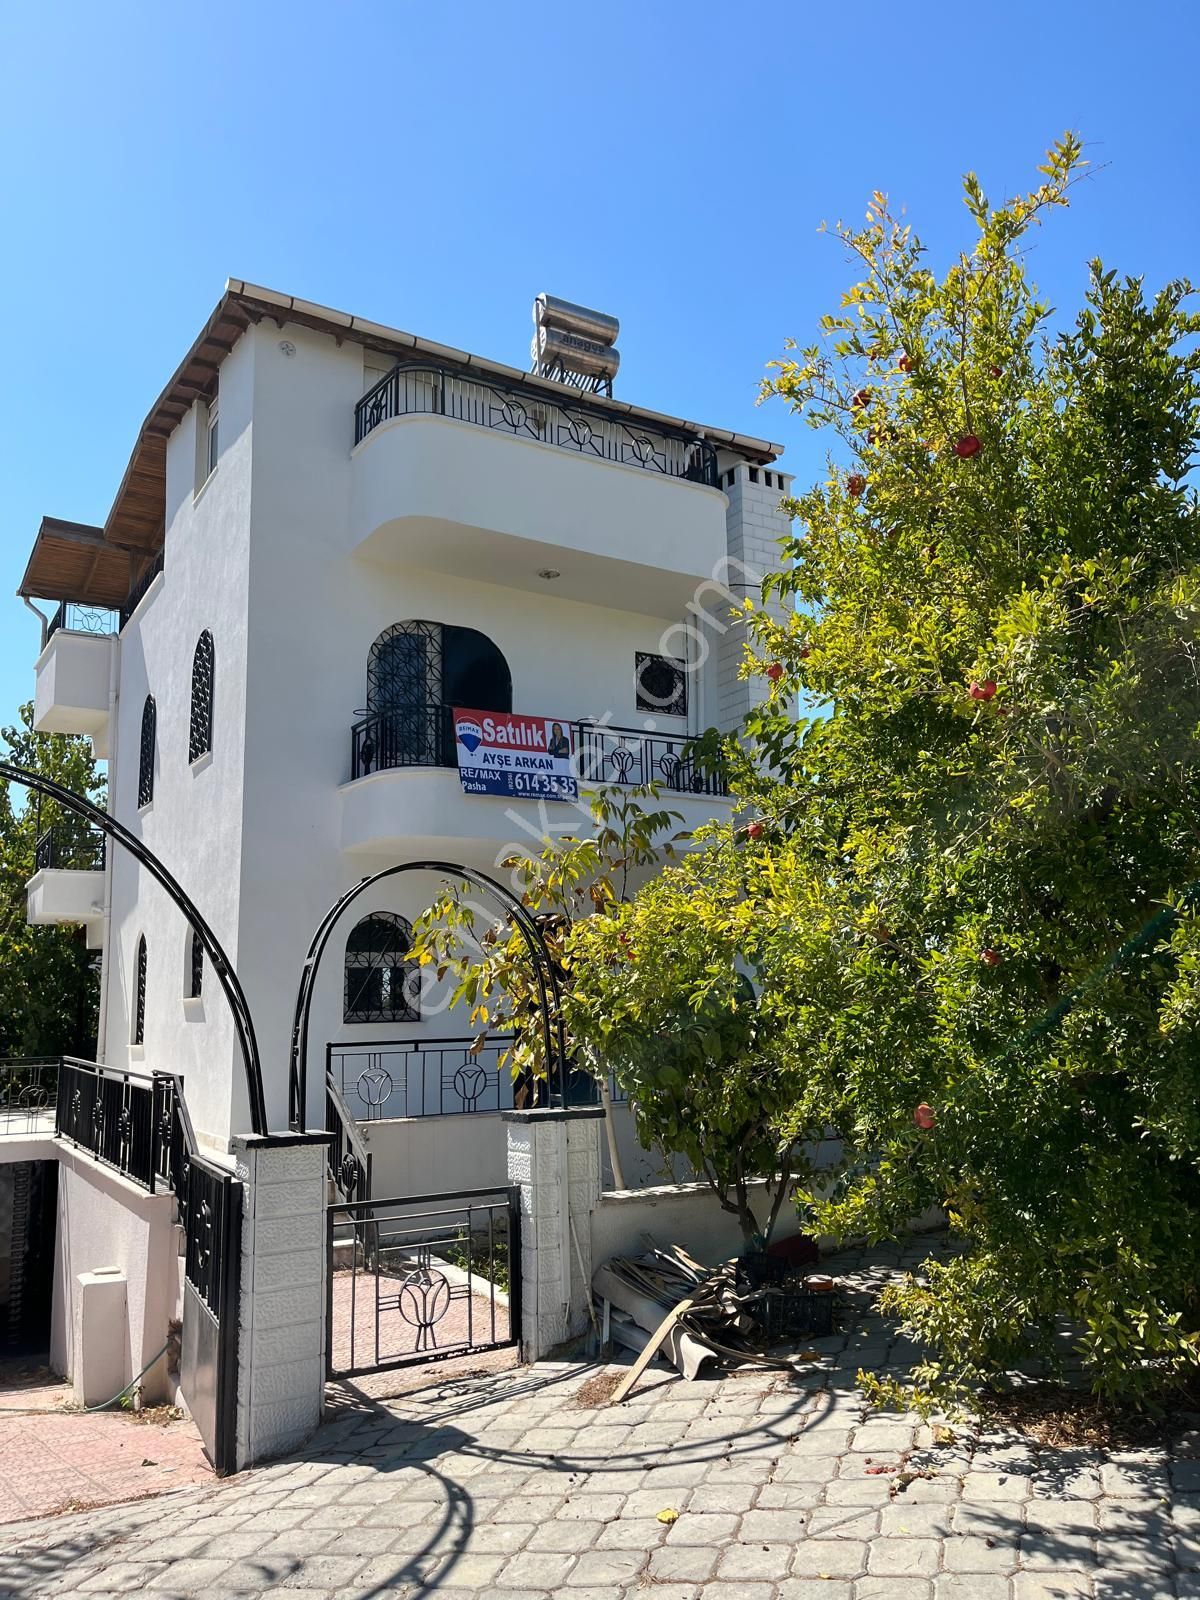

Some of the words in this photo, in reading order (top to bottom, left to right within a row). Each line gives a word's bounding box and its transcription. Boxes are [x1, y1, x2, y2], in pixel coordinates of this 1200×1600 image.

[482, 718, 545, 748] Satılık
[482, 753, 512, 769] AYŞE
[515, 756, 554, 770] ARKAN
[460, 768, 501, 781] RE/MAX
[462, 780, 487, 791] Pasha
[514, 774, 540, 791] 614
[542, 776, 558, 793] 35
[561, 777, 576, 794] 35
